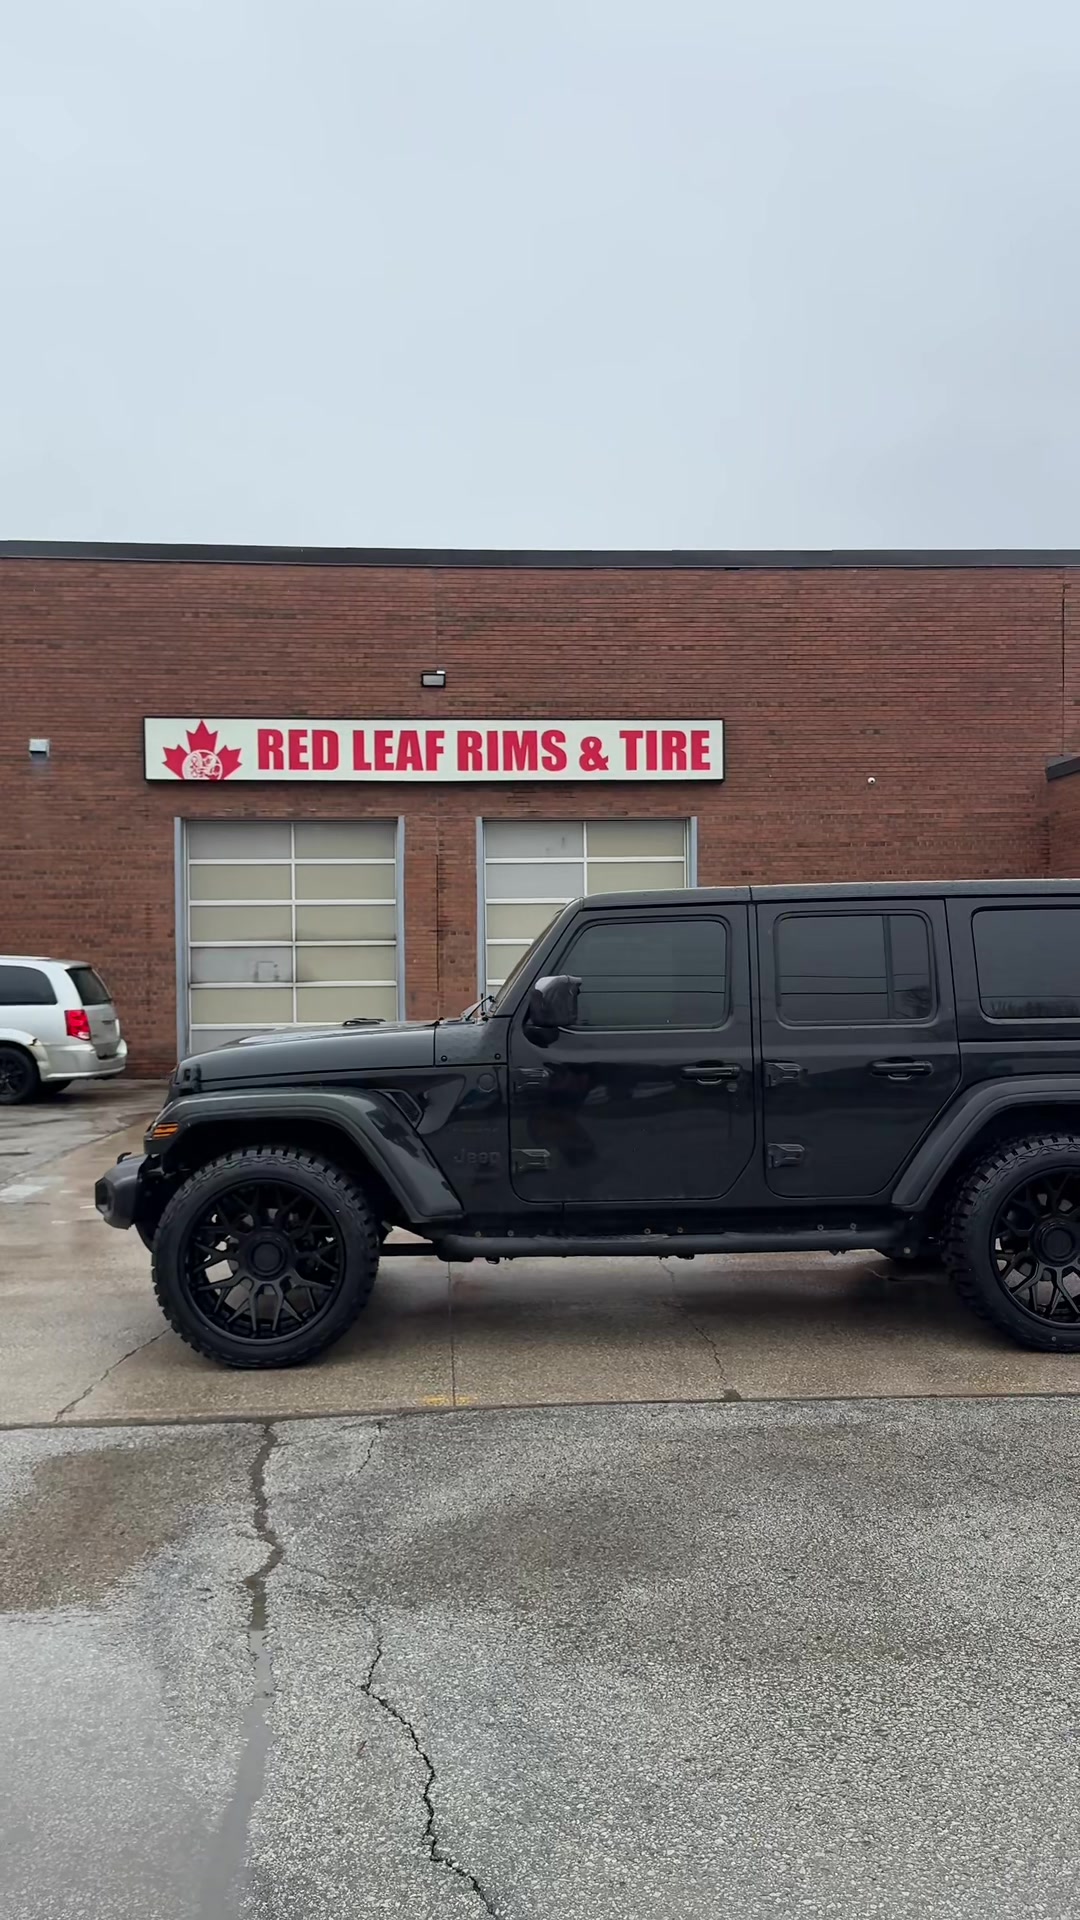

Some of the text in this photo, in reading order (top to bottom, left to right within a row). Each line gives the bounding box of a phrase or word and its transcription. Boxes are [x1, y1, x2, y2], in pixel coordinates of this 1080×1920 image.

[257, 729, 711, 773] RED LEAF RIMS & TIRE
[453, 1148, 501, 1167] Jeep
